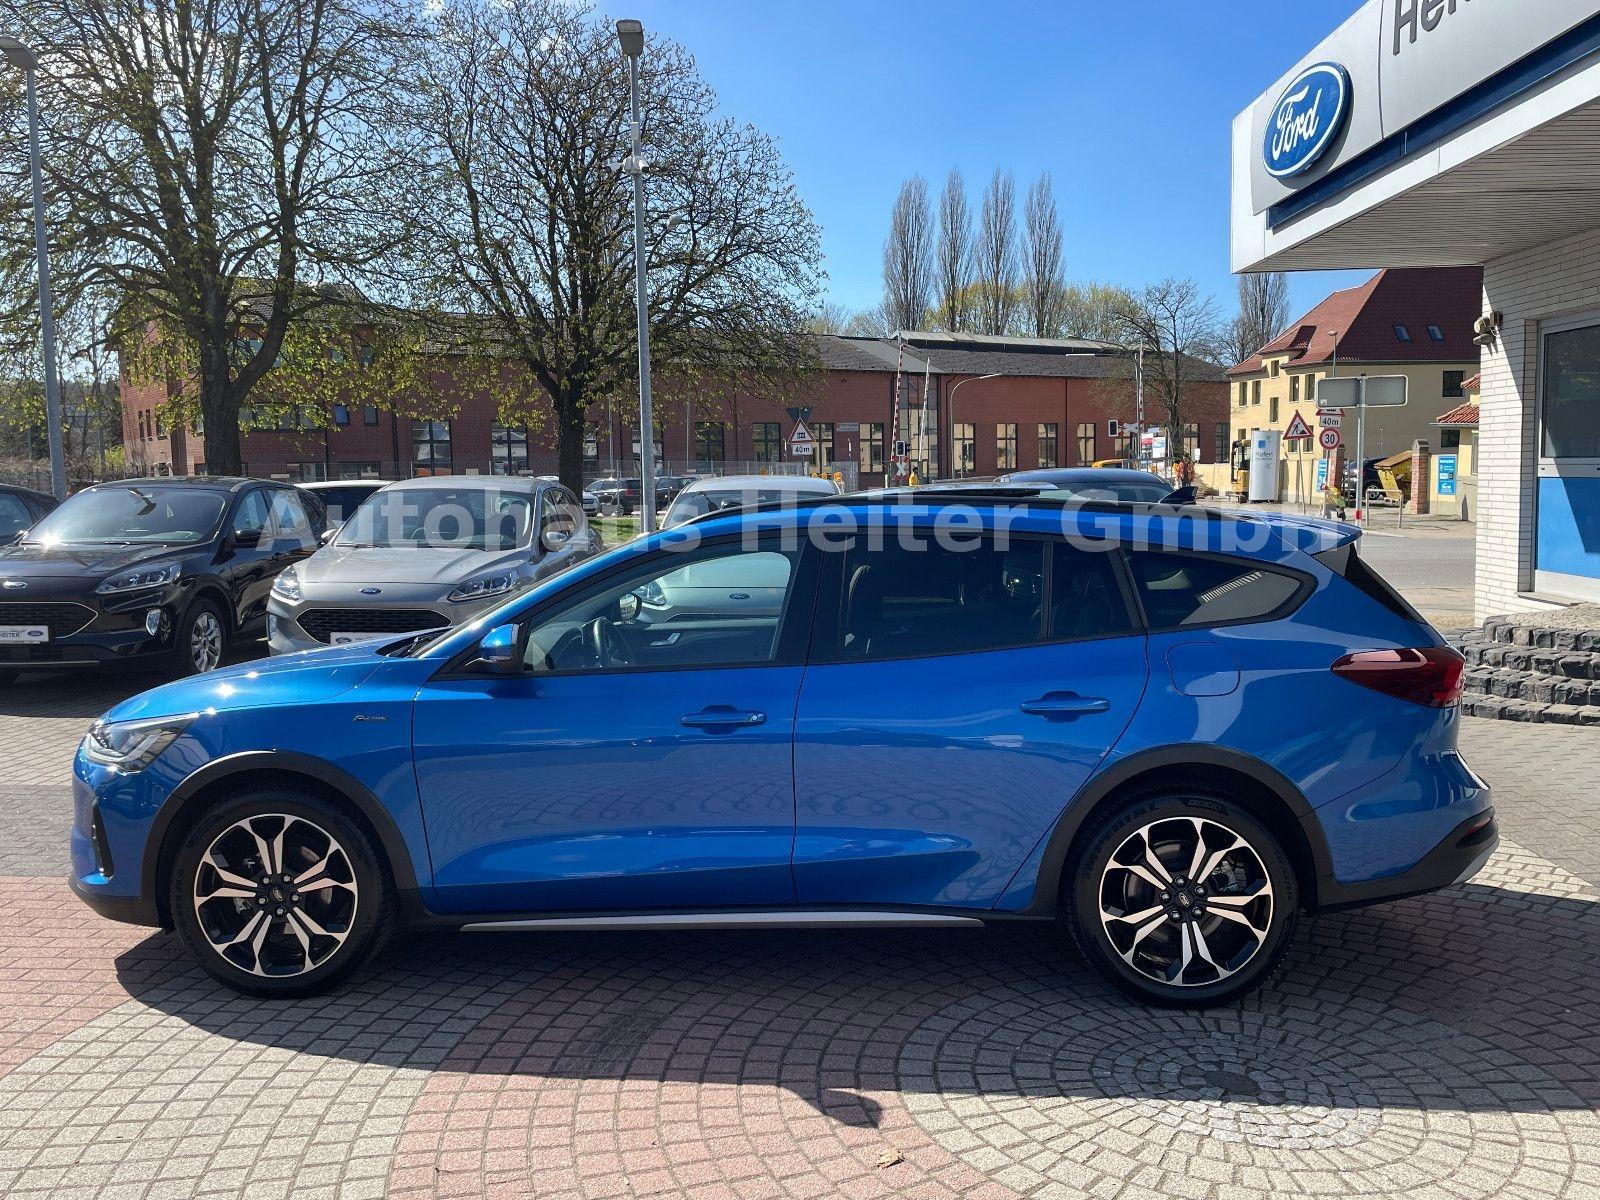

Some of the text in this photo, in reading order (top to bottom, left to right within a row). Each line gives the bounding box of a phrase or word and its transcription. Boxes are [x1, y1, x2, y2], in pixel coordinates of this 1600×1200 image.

[1393, 0, 1472, 56] He
[1272, 85, 1322, 160] Ford
[1324, 433, 1336, 444] 30
